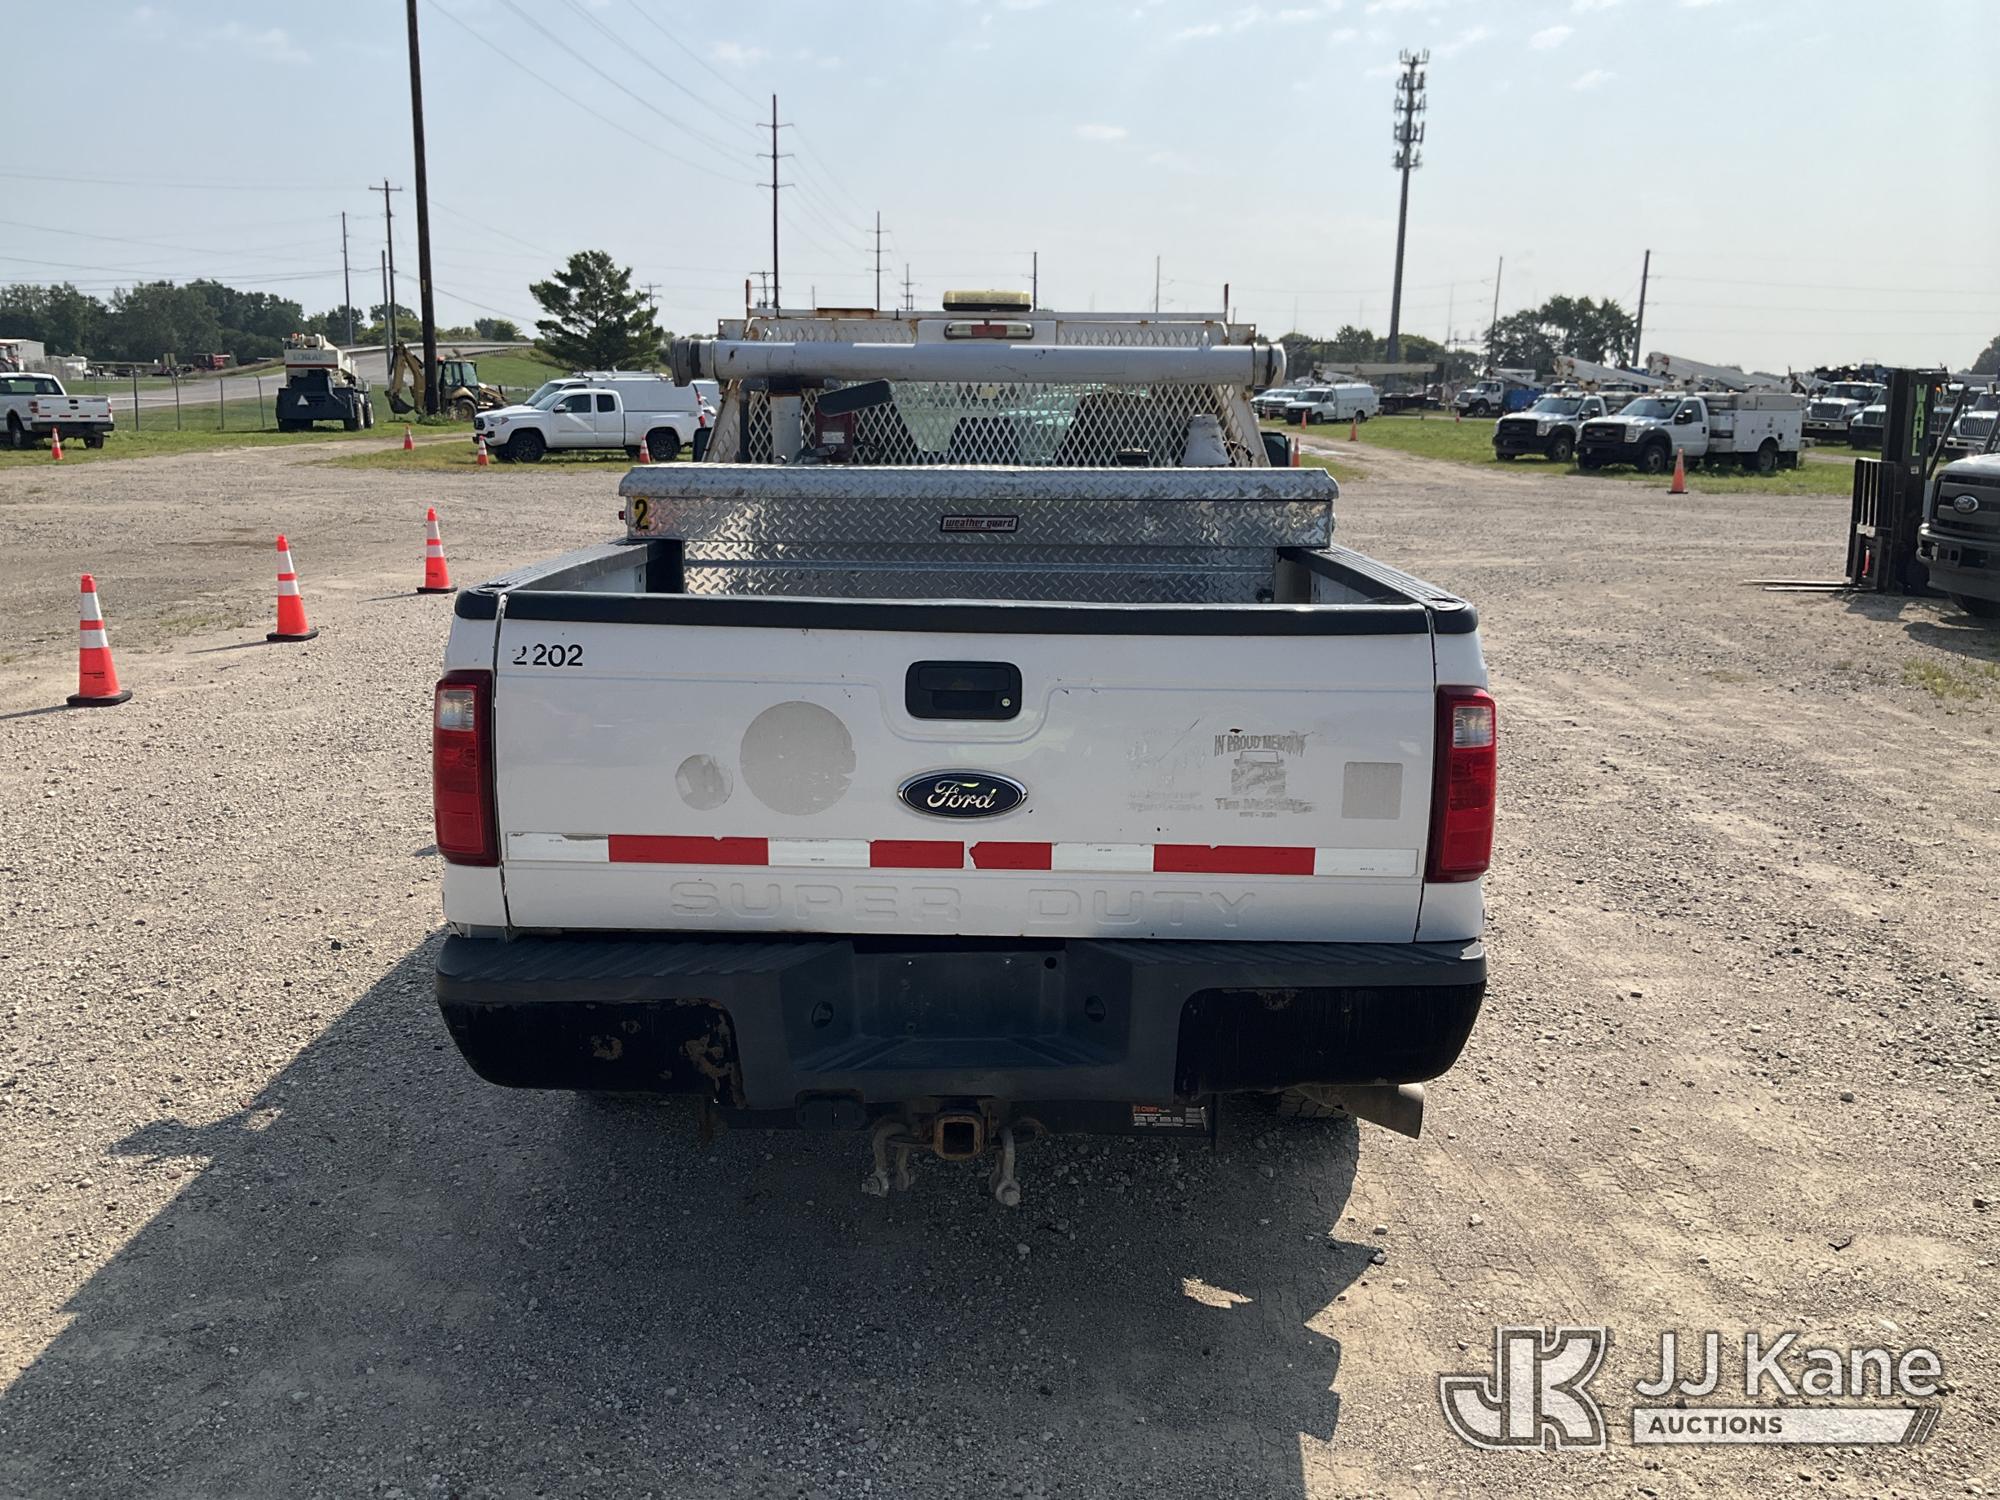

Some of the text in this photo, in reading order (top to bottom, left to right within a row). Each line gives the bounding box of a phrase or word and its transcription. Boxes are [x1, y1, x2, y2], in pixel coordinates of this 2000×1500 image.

[1911, 384, 1928, 456] WAHL
[635, 499, 649, 531] 2
[945, 518, 1015, 529] weather guard
[1227, 734, 1261, 753] PROUD
[927, 780, 997, 809] Ford
[670, 881, 1256, 928] SUPER DUTY
